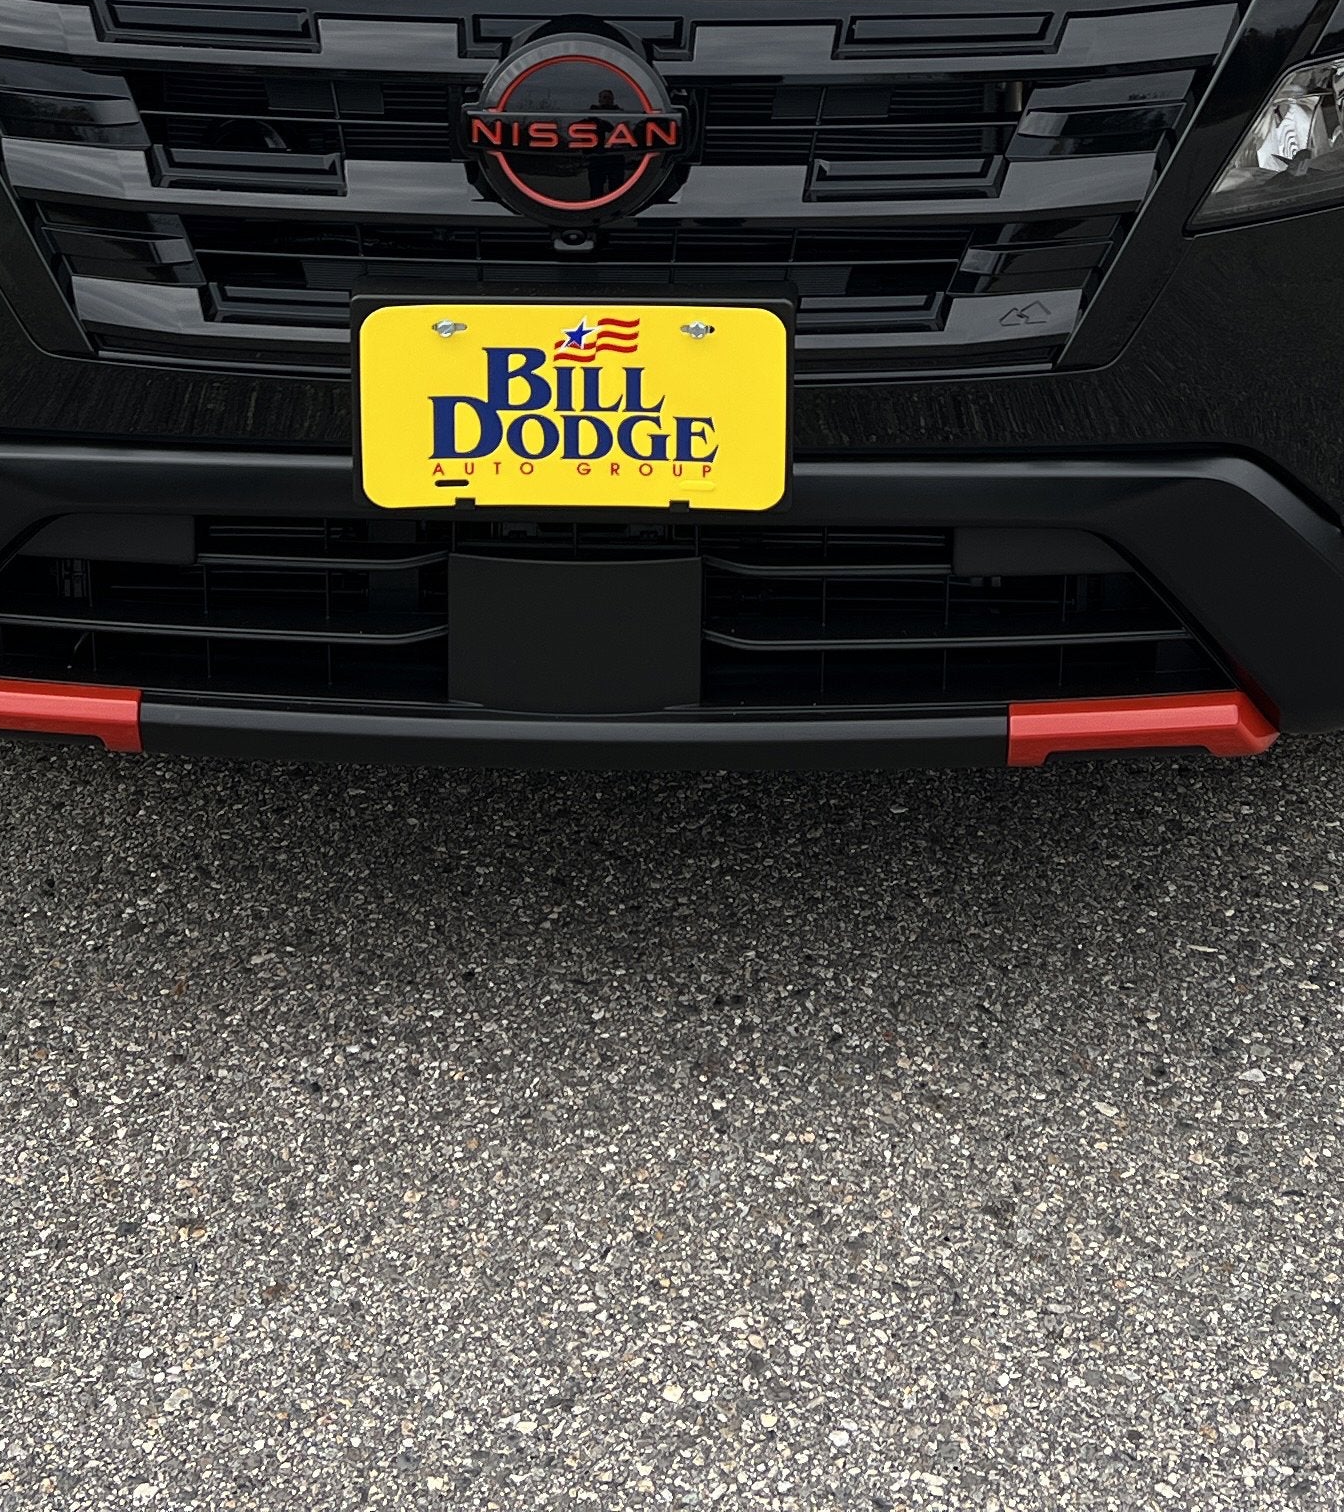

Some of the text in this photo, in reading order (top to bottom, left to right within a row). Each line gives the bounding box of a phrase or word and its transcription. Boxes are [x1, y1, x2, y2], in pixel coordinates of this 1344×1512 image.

[471, 118, 677, 148] NISSAN
[482, 346, 666, 413] BILL
[427, 395, 720, 464] DODGE
[432, 462, 713, 478] AUTO GROUP
